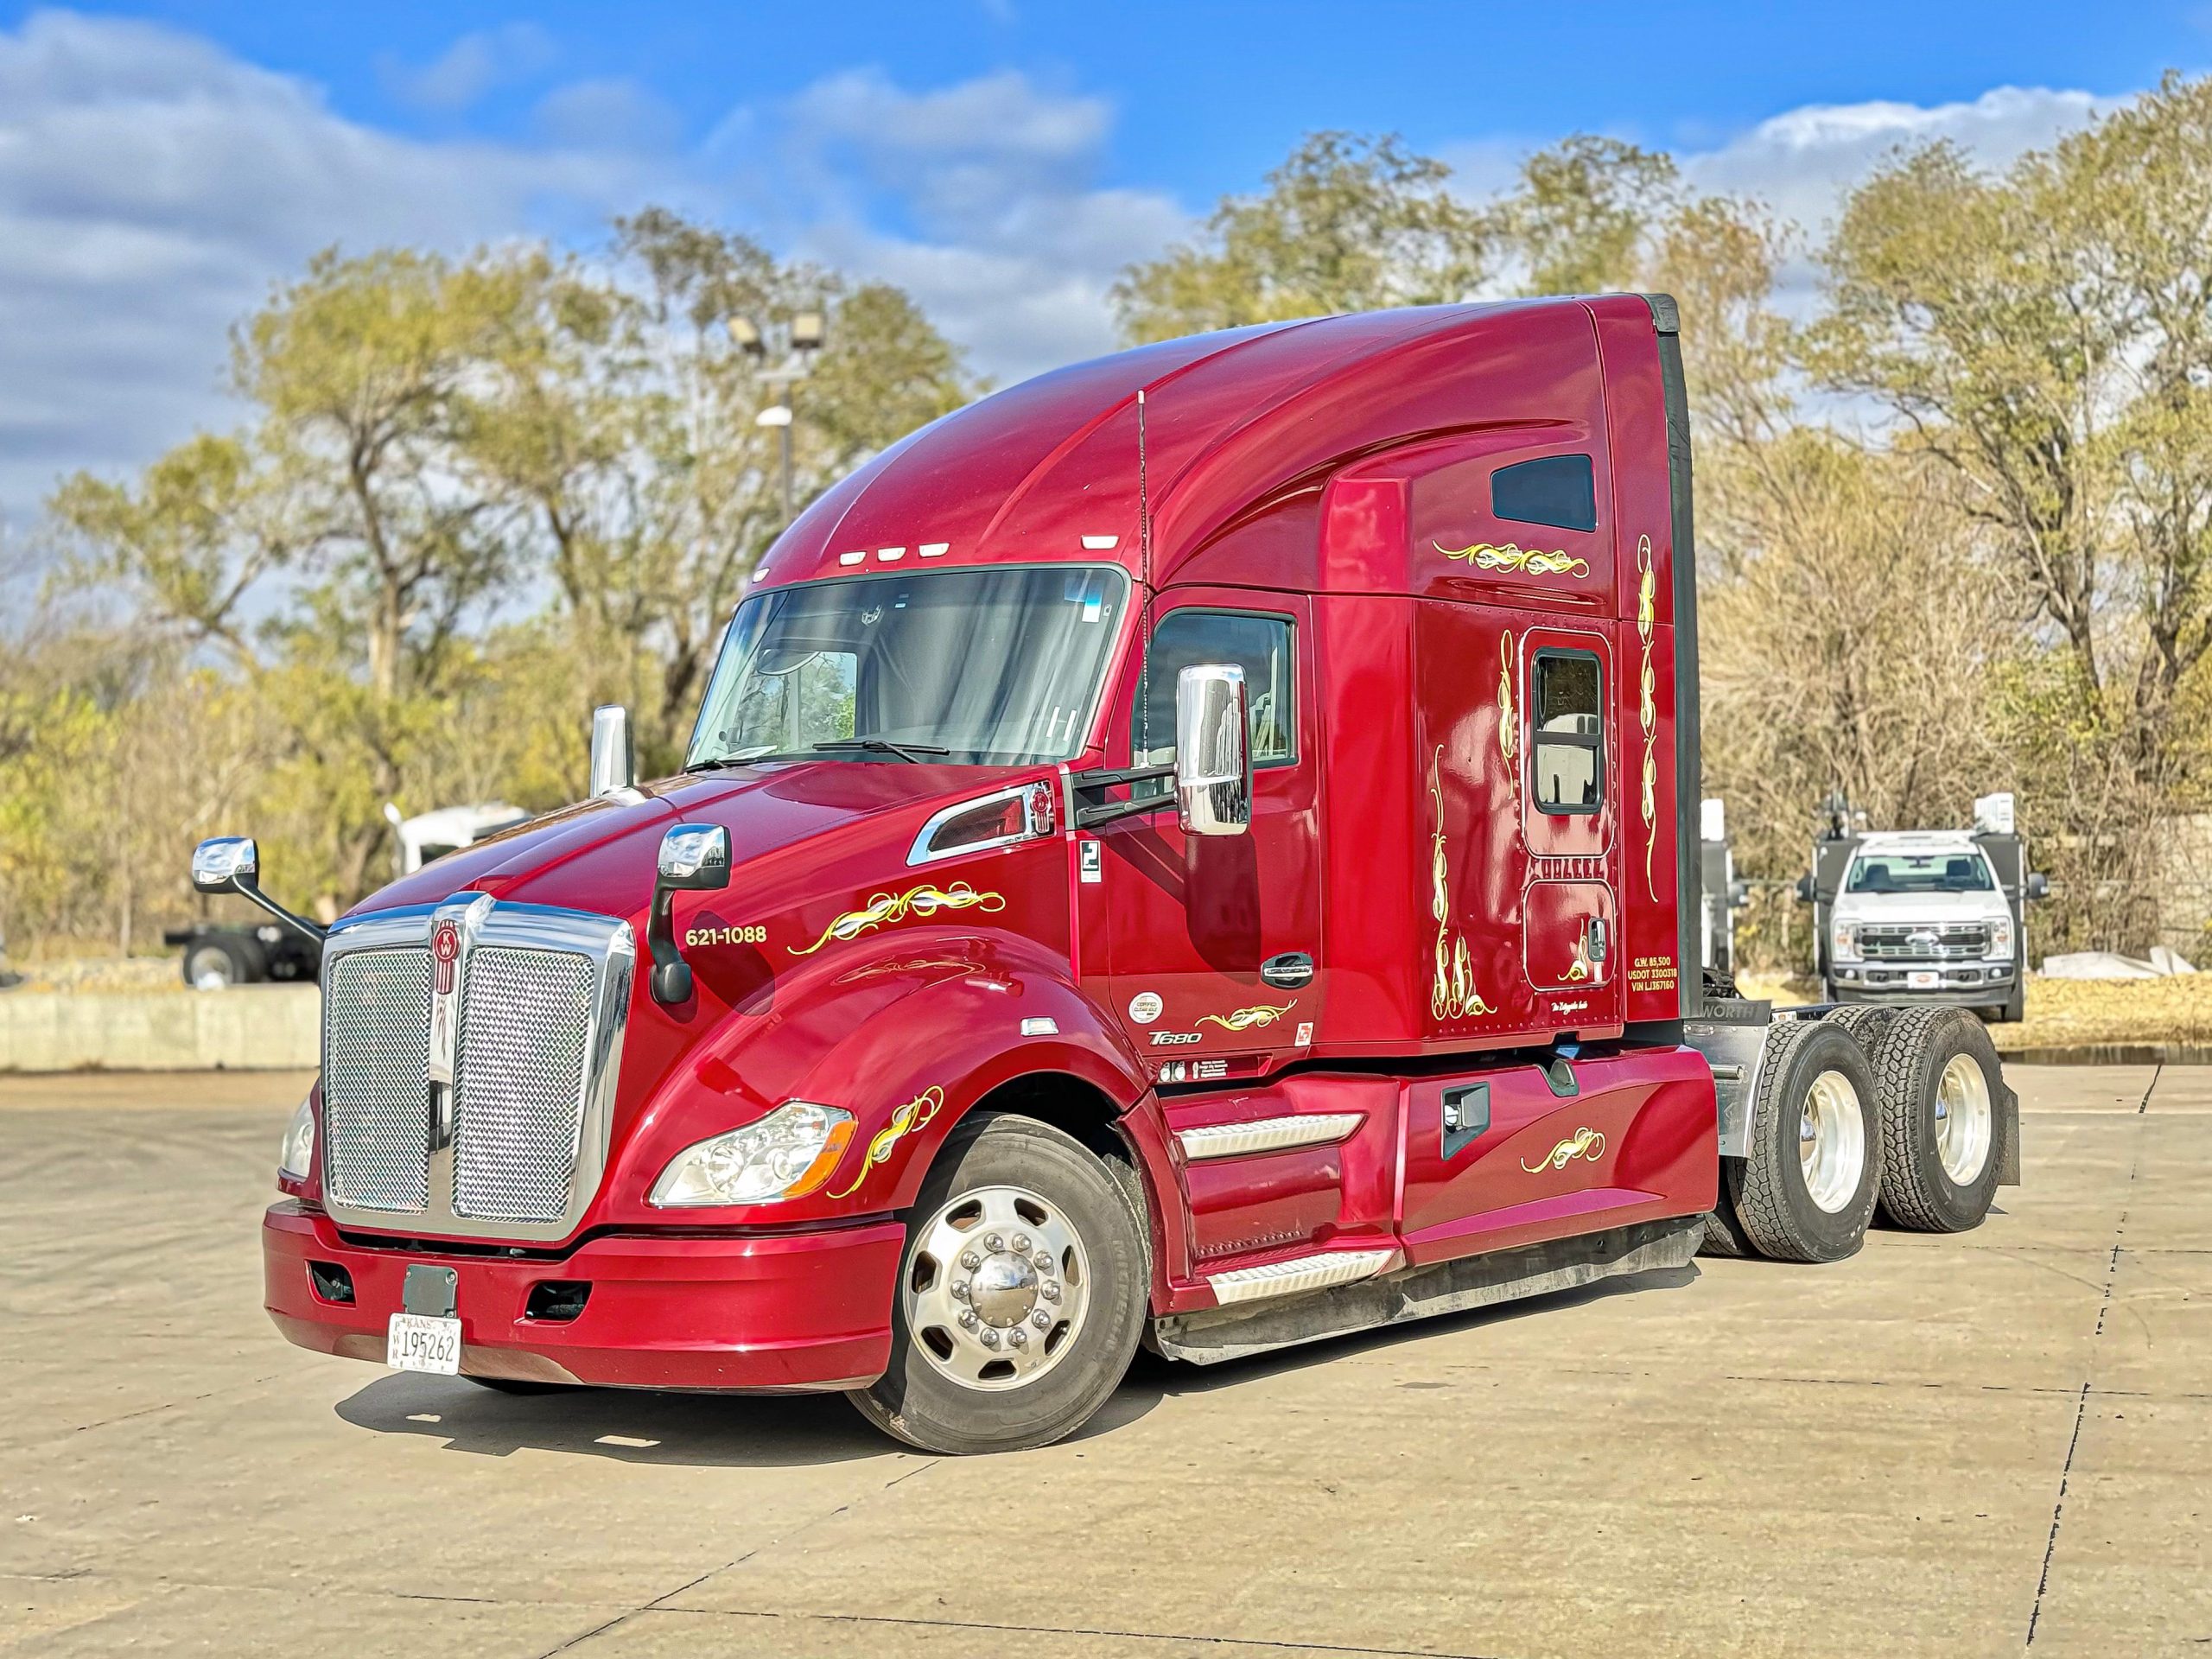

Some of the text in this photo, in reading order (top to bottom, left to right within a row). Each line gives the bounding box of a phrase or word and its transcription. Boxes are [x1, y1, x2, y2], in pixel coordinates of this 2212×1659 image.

[685, 925, 767, 947] 621-1088
[1649, 956, 1671, 969] 85,500
[1627, 969, 1650, 980] USDOT
[1631, 982, 1644, 992] VIN
[1147, 1031, 1203, 1046] T680
[402, 1331, 454, 1362] 195262
